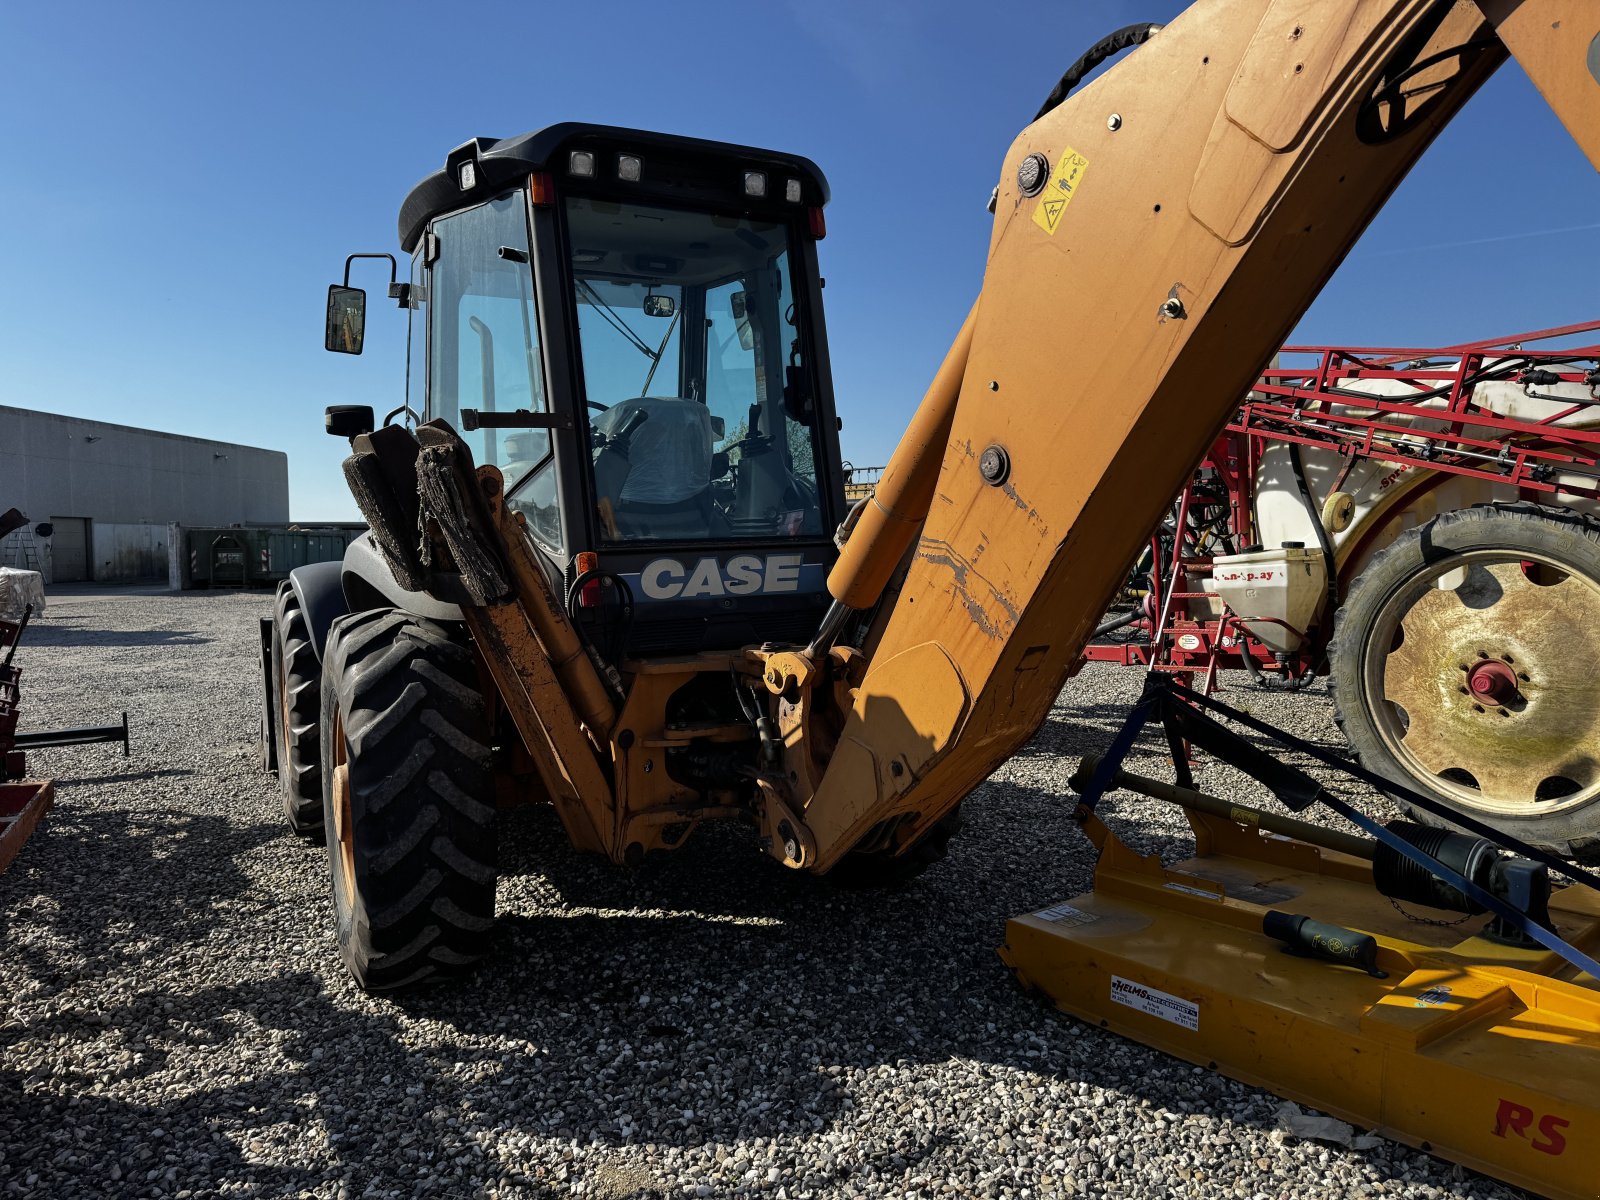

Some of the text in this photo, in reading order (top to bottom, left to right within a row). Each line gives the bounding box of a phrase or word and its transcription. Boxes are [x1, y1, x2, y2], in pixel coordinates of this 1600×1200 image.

[641, 555, 801, 599] CASE
[1114, 980, 1148, 1000] HELMS
[1491, 1098, 1570, 1155] RS
